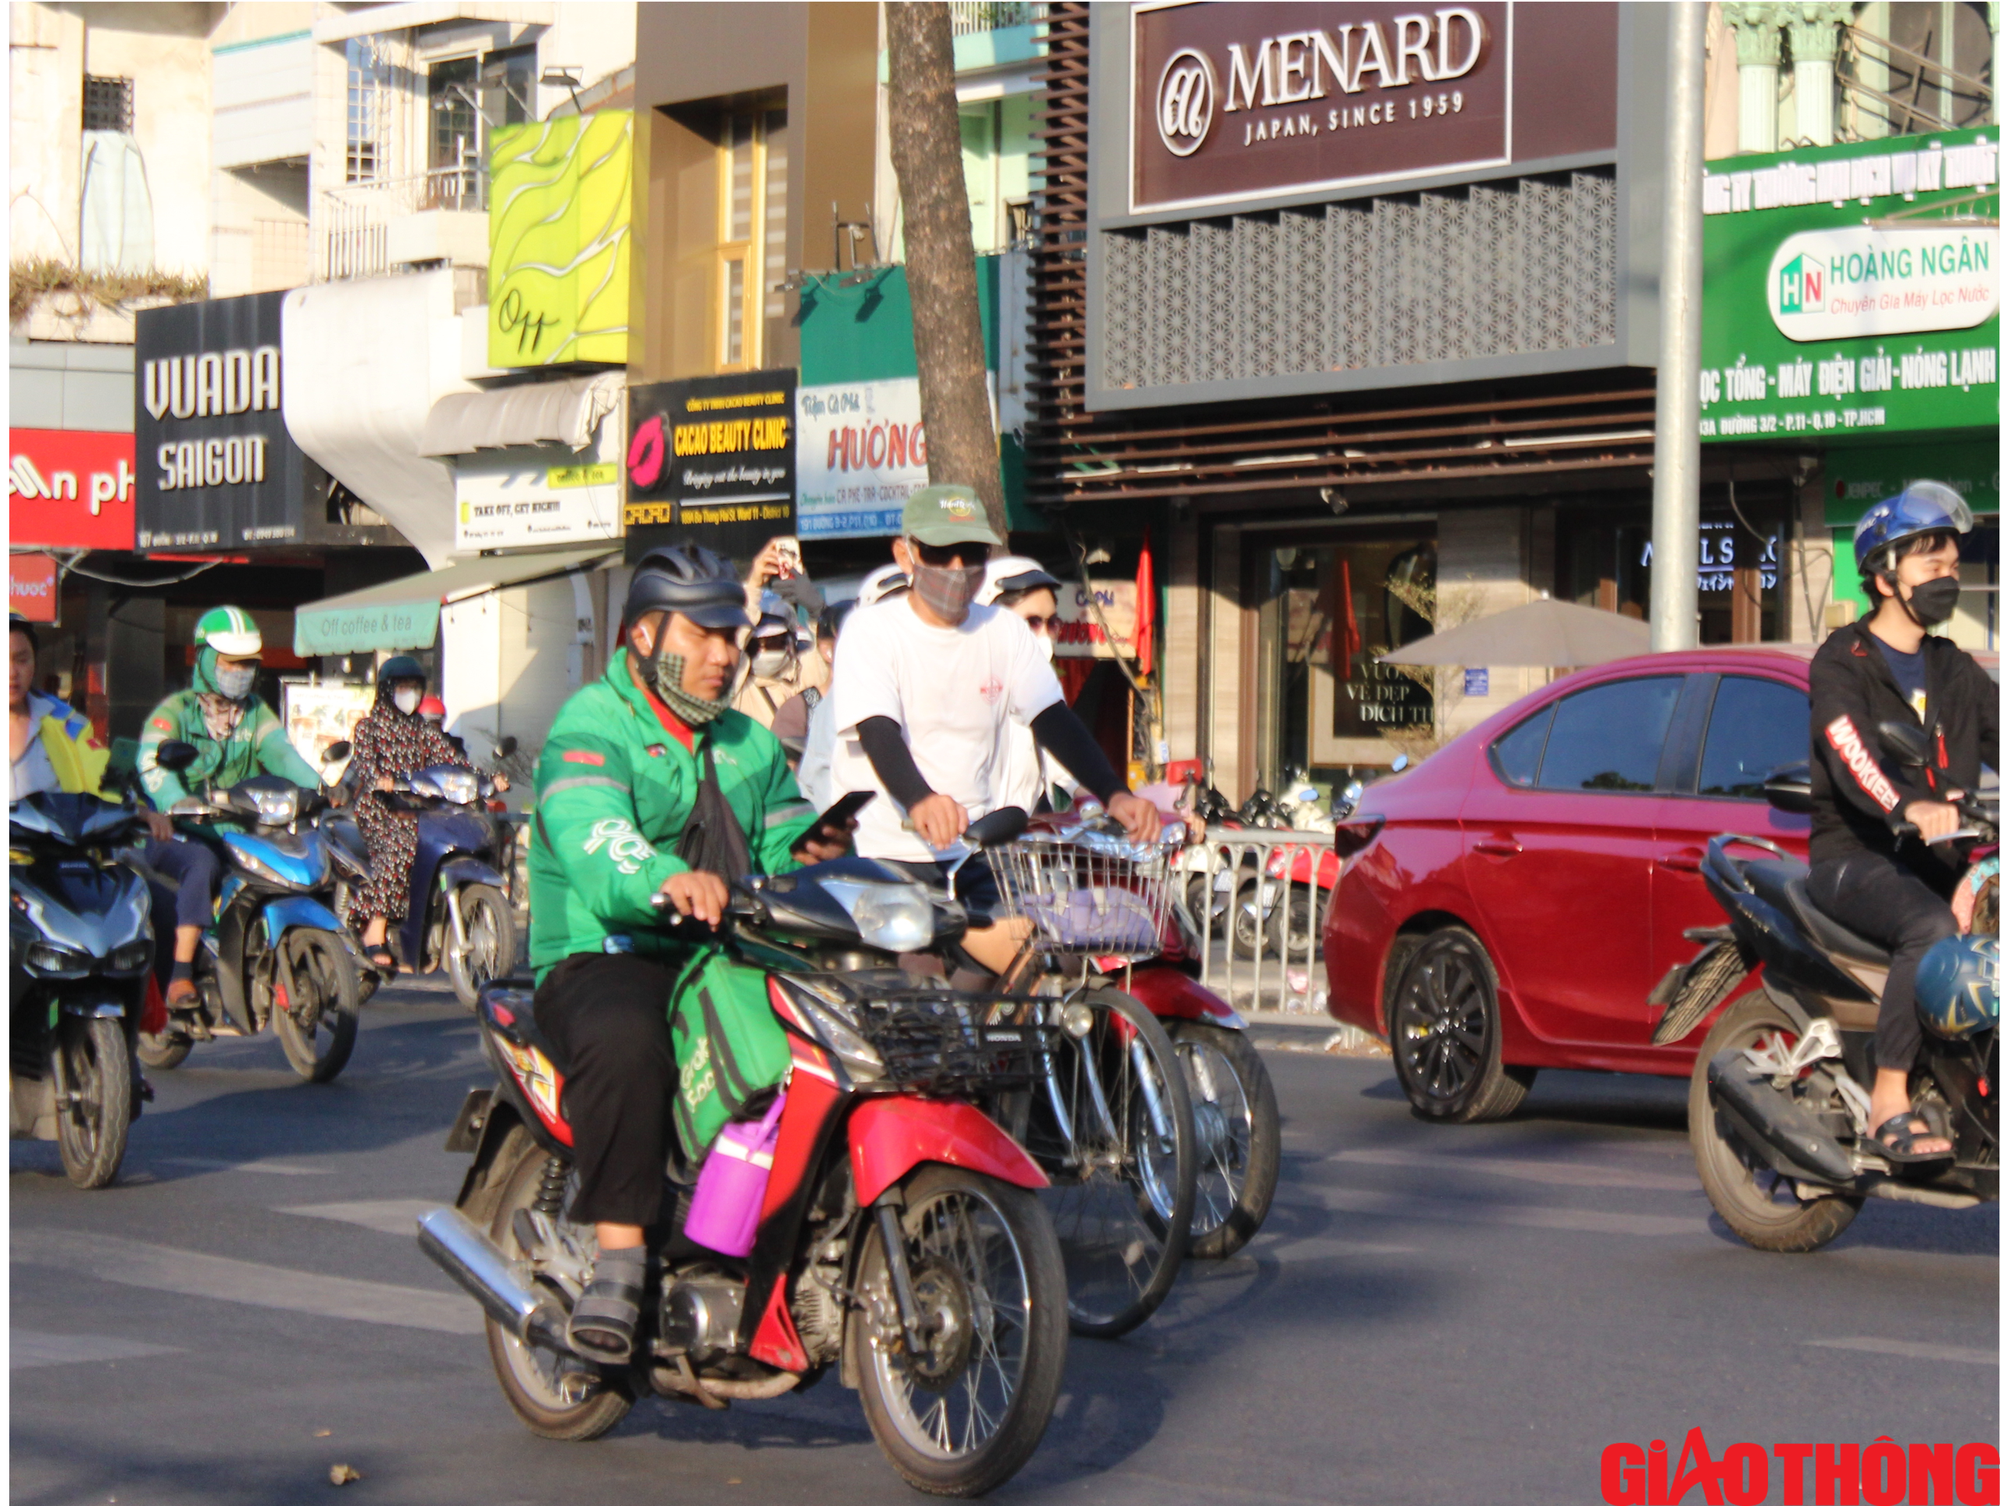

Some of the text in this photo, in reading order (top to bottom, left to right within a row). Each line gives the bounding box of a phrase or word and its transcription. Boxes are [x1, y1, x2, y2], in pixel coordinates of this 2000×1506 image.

[1224, 7, 1483, 112] MENARD
[1244, 91, 1464, 146] JAPAN, SINCE 1959
[1831, 236, 1989, 285] HOÀNG NGÂN
[1831, 284, 1990, 317] Chuyên Gia Máy Lọc Nước
[1700, 370, 1720, 410] ỌC
[1726, 353, 1766, 401] TỔNG
[1778, 355, 1813, 399] MÁY
[1818, 353, 1855, 400] ĐIỆN
[1860, 346, 1892, 393] GIẢI
[1951, 348, 1996, 393] LẠNH
[674, 416, 787, 457] CACAO BEAUTY CLINIC
[827, 418, 928, 473] HƯƠNG
[1721, 413, 1757, 435] ĐƯỜNG
[1759, 415, 1777, 432] 3/2
[1786, 412, 1806, 431] P.11
[158, 434, 267, 491] SAIGON
[474, 505, 494, 517] TAKE
[322, 614, 412, 637] Off coffee & tea
[986, 1032, 1021, 1042] HONDA
